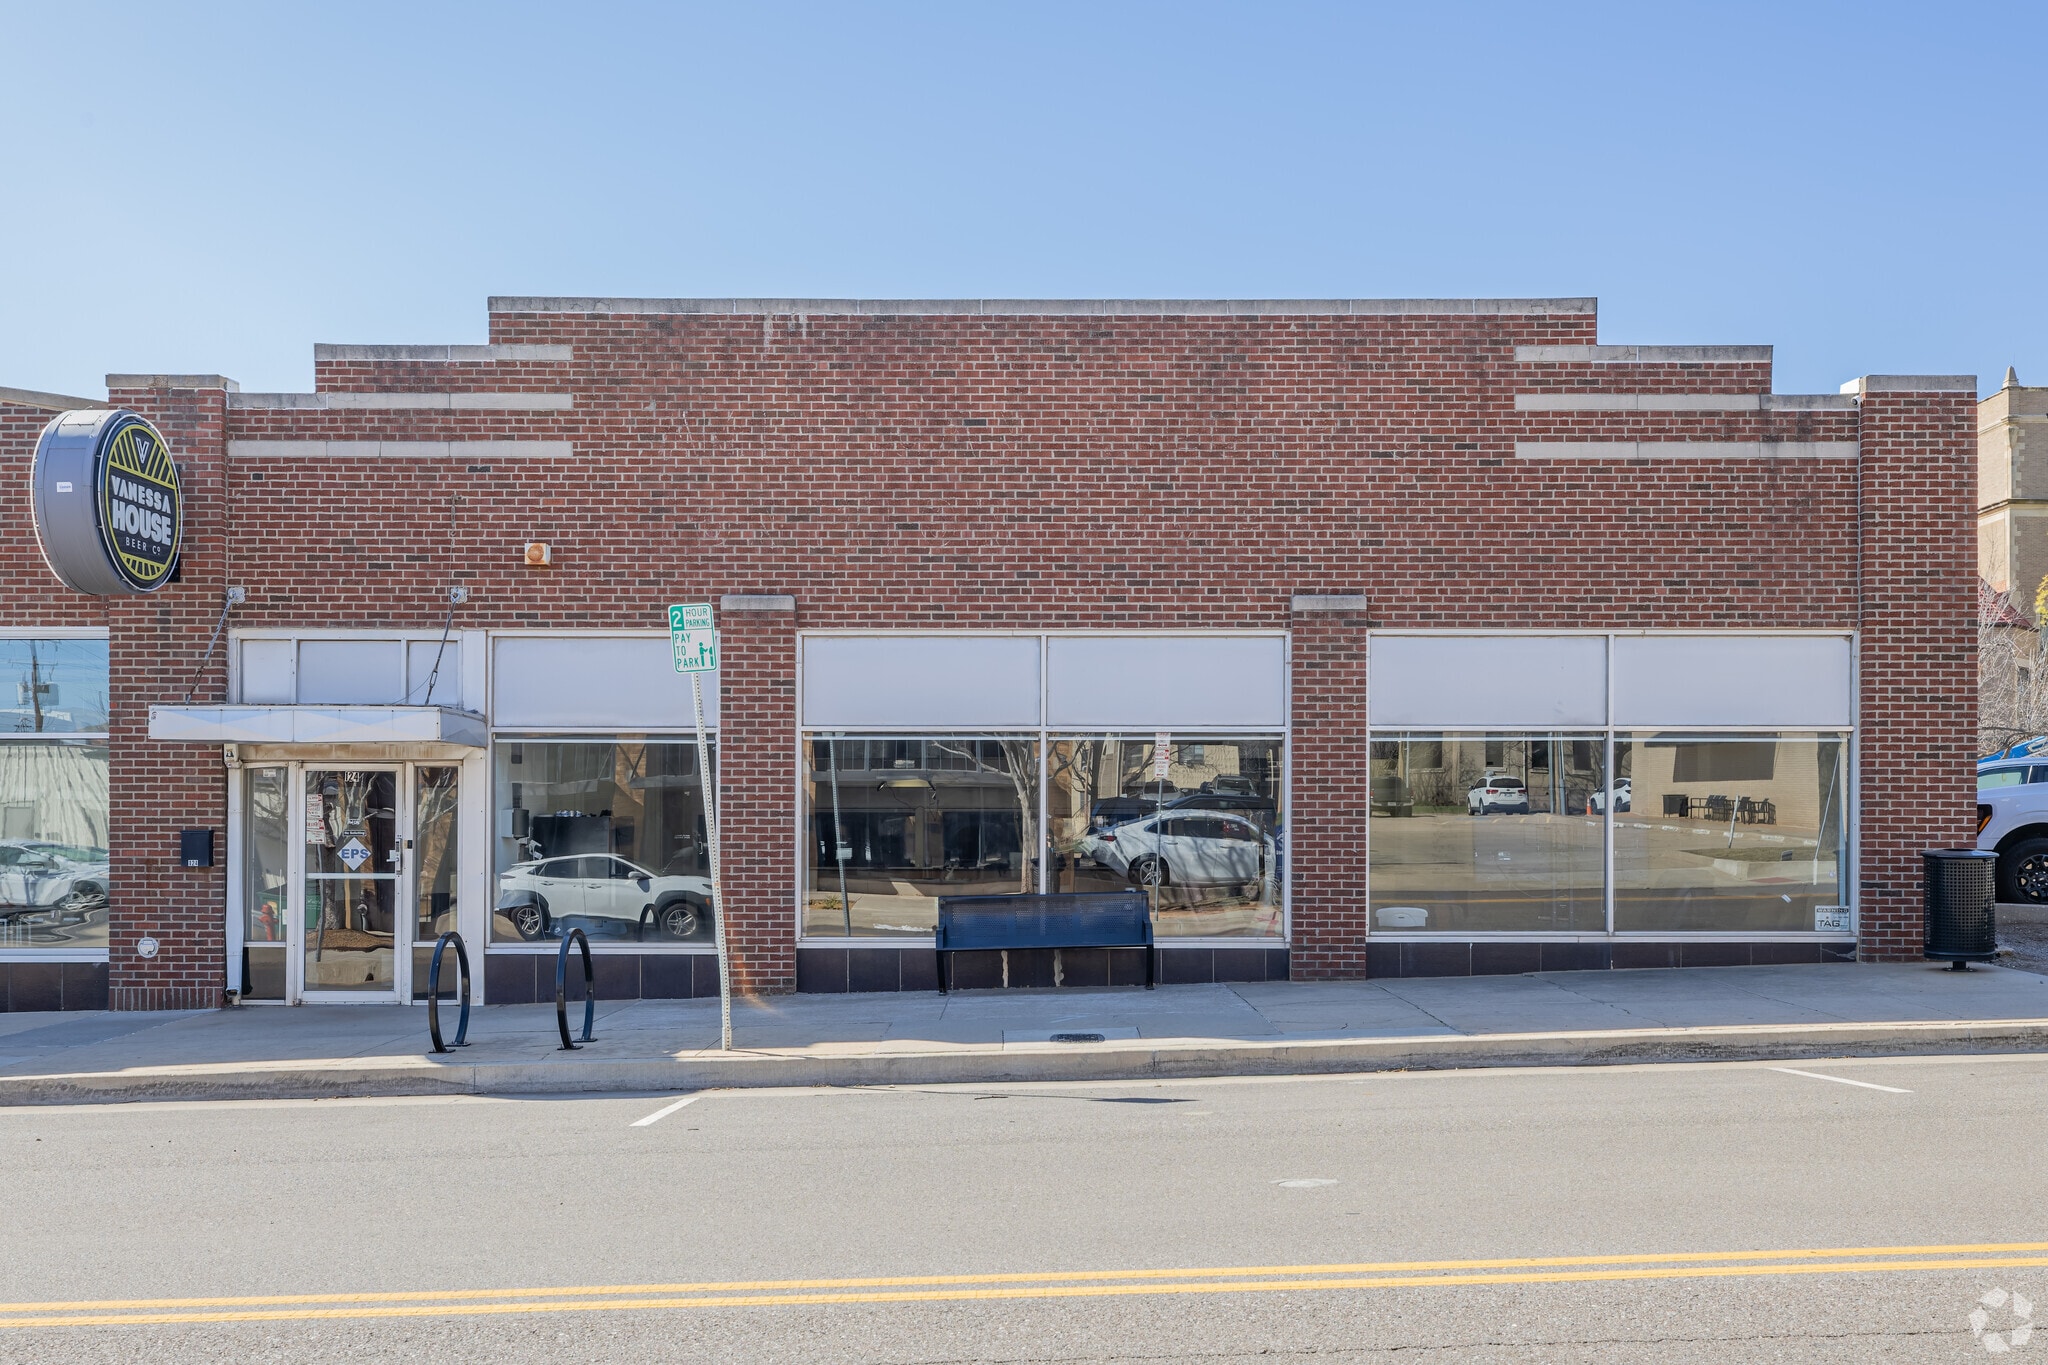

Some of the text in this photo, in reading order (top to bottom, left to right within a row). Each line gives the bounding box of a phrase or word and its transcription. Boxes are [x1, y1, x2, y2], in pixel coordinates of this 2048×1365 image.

[135, 436, 150, 464] V
[111, 474, 172, 514] VANESSA
[112, 498, 171, 546] HOUSE
[126, 537, 147, 552] BEER
[672, 608, 708, 628] 2 HOUR
[685, 618, 710, 627] PARKING
[674, 633, 691, 644] PAY
[676, 645, 687, 657] TO
[677, 657, 699, 668] PARK
[345, 772, 359, 782] 124
[341, 848, 369, 859] EPS
[1817, 919, 1841, 928] TAG
